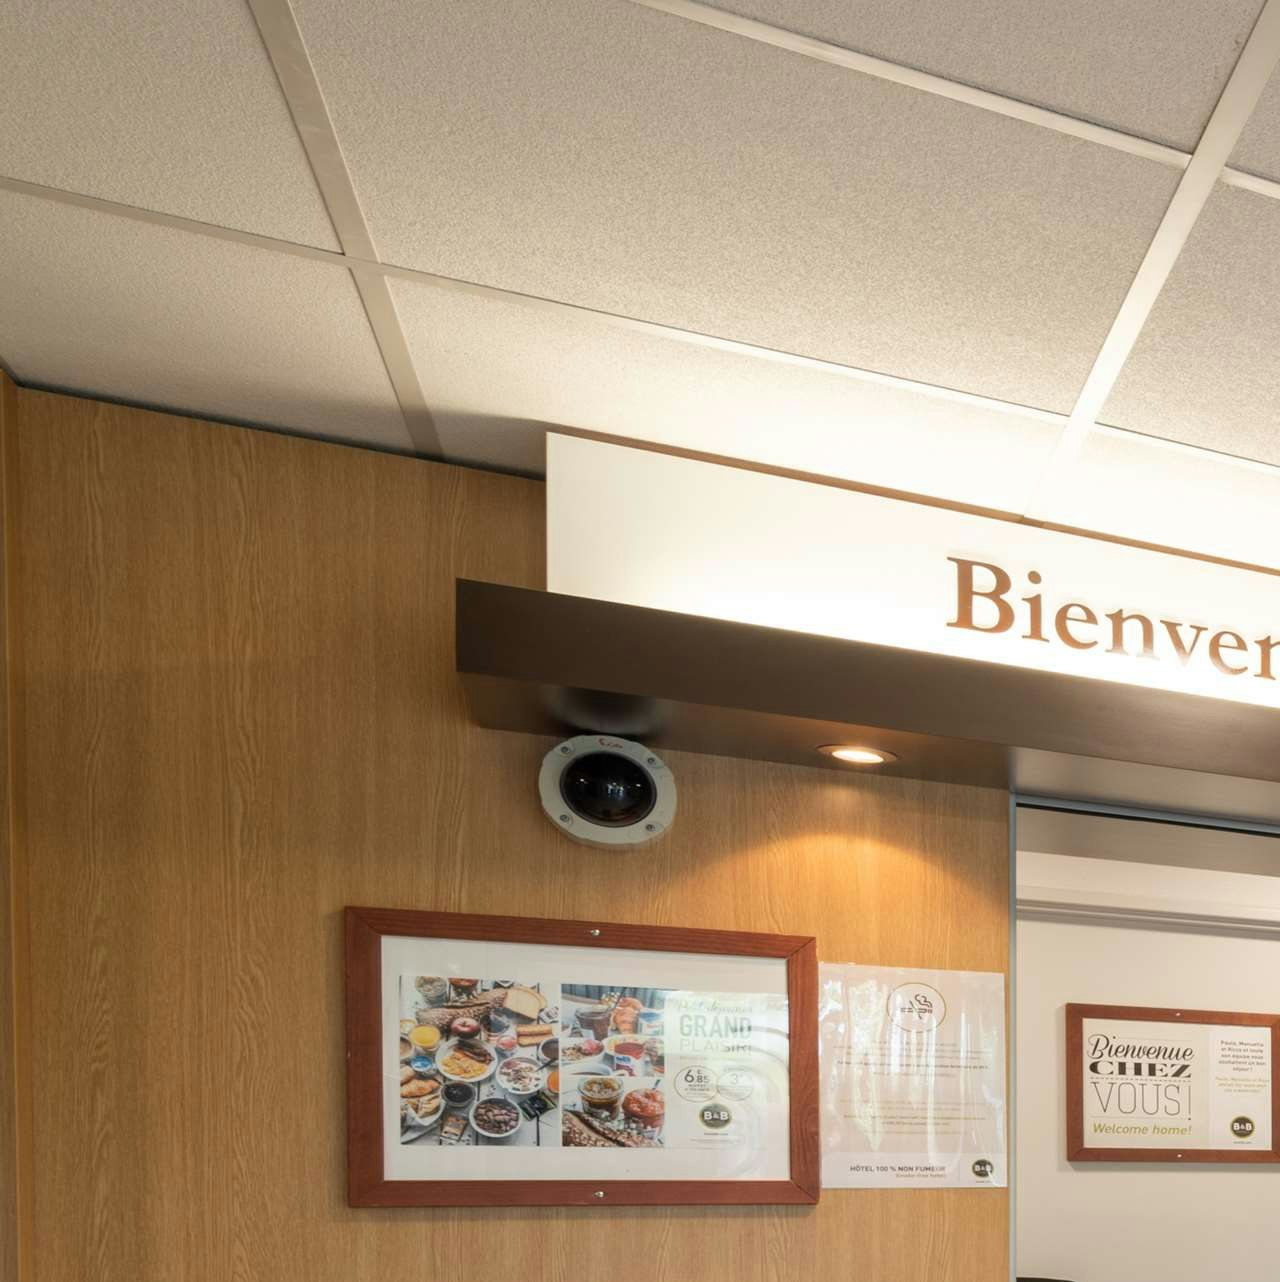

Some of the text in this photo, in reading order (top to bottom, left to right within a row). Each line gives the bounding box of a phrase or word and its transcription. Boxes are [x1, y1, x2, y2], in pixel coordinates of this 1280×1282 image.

[680, 1014, 752, 1039] GRAND
[1087, 1034, 1194, 1060] Bienvenue
[1089, 1061, 1192, 1078] CHEZ
[704, 1111, 729, 1120] B&B
[1093, 1122, 1192, 1136] Welcome home!
